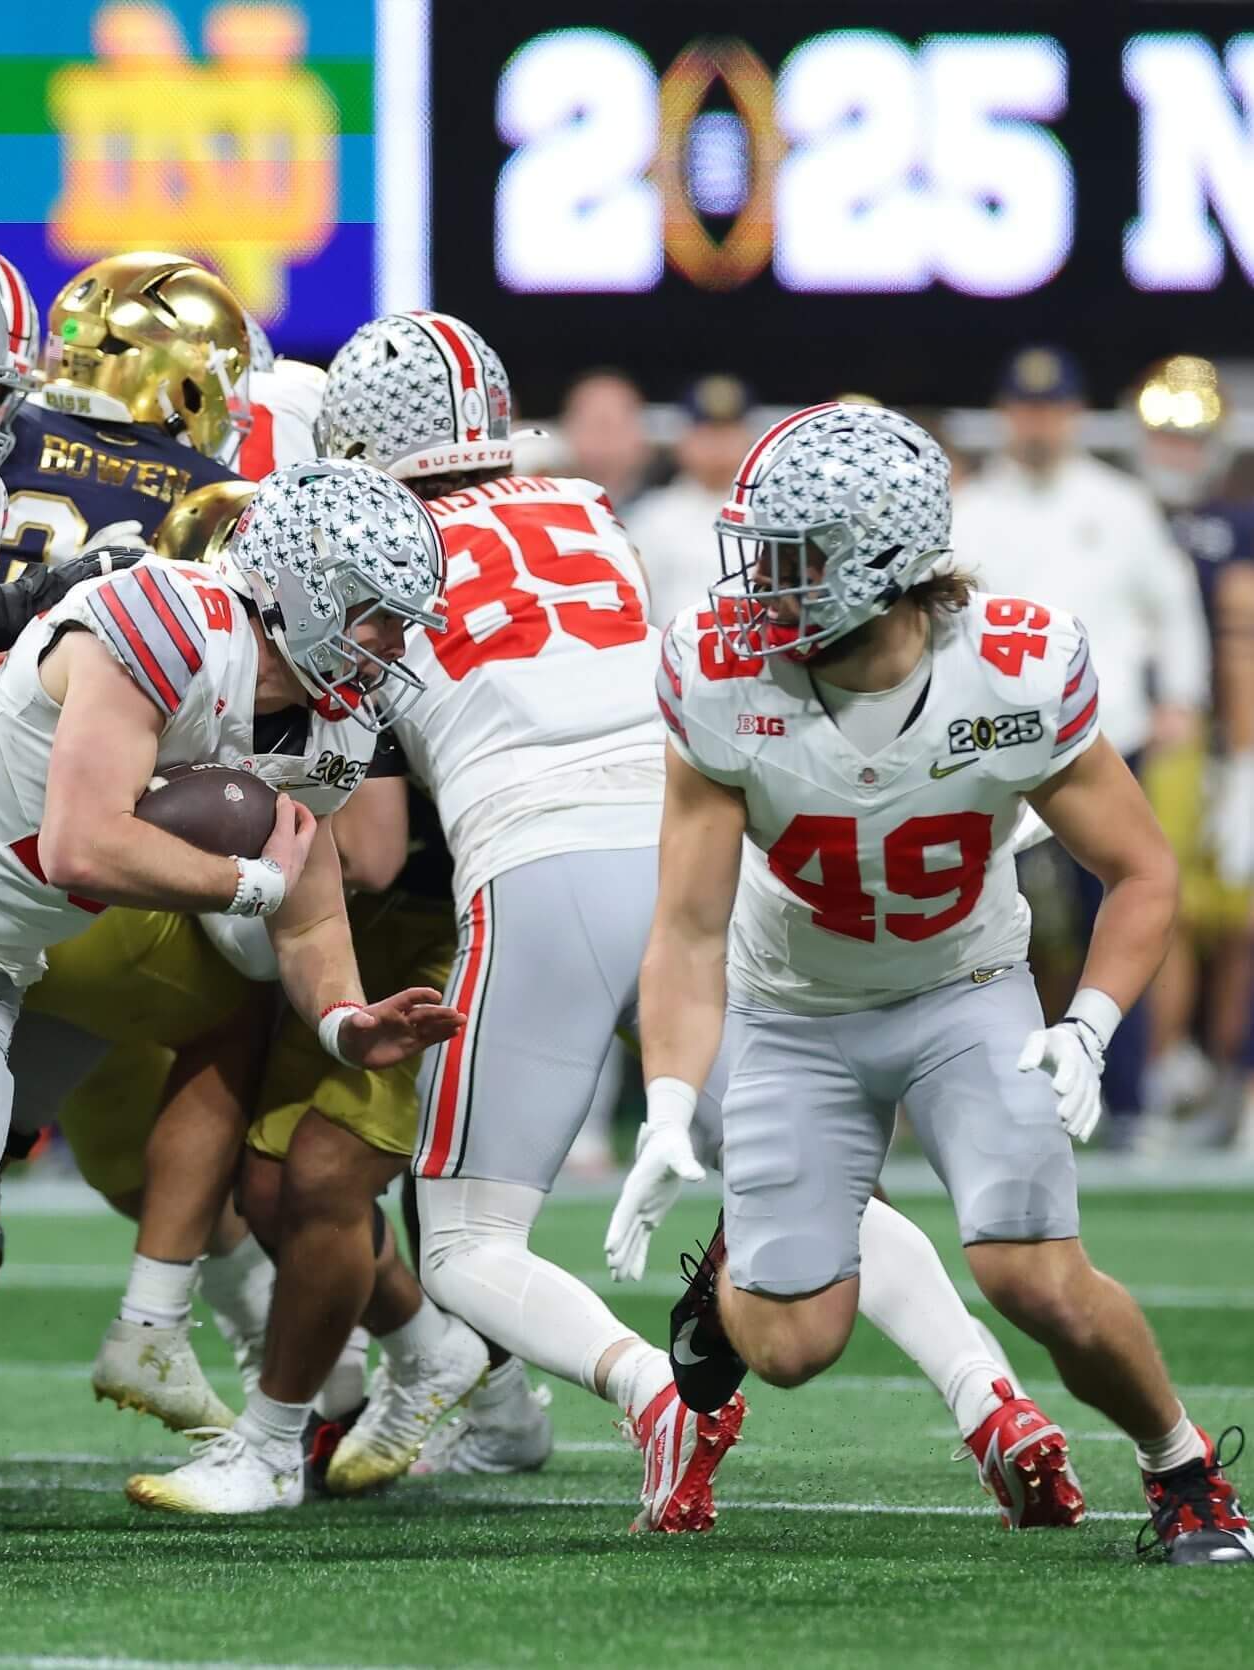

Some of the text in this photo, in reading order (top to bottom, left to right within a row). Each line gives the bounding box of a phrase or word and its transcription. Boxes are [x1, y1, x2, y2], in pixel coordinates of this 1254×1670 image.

[38, 433, 193, 503] BOWEN
[418, 449, 513, 470] BUCKEYES
[424, 502, 648, 682] 85
[979, 597, 1051, 677] 49
[735, 714, 787, 737] BIG
[947, 710, 1044, 755] 2025
[767, 810, 995, 944] 49
